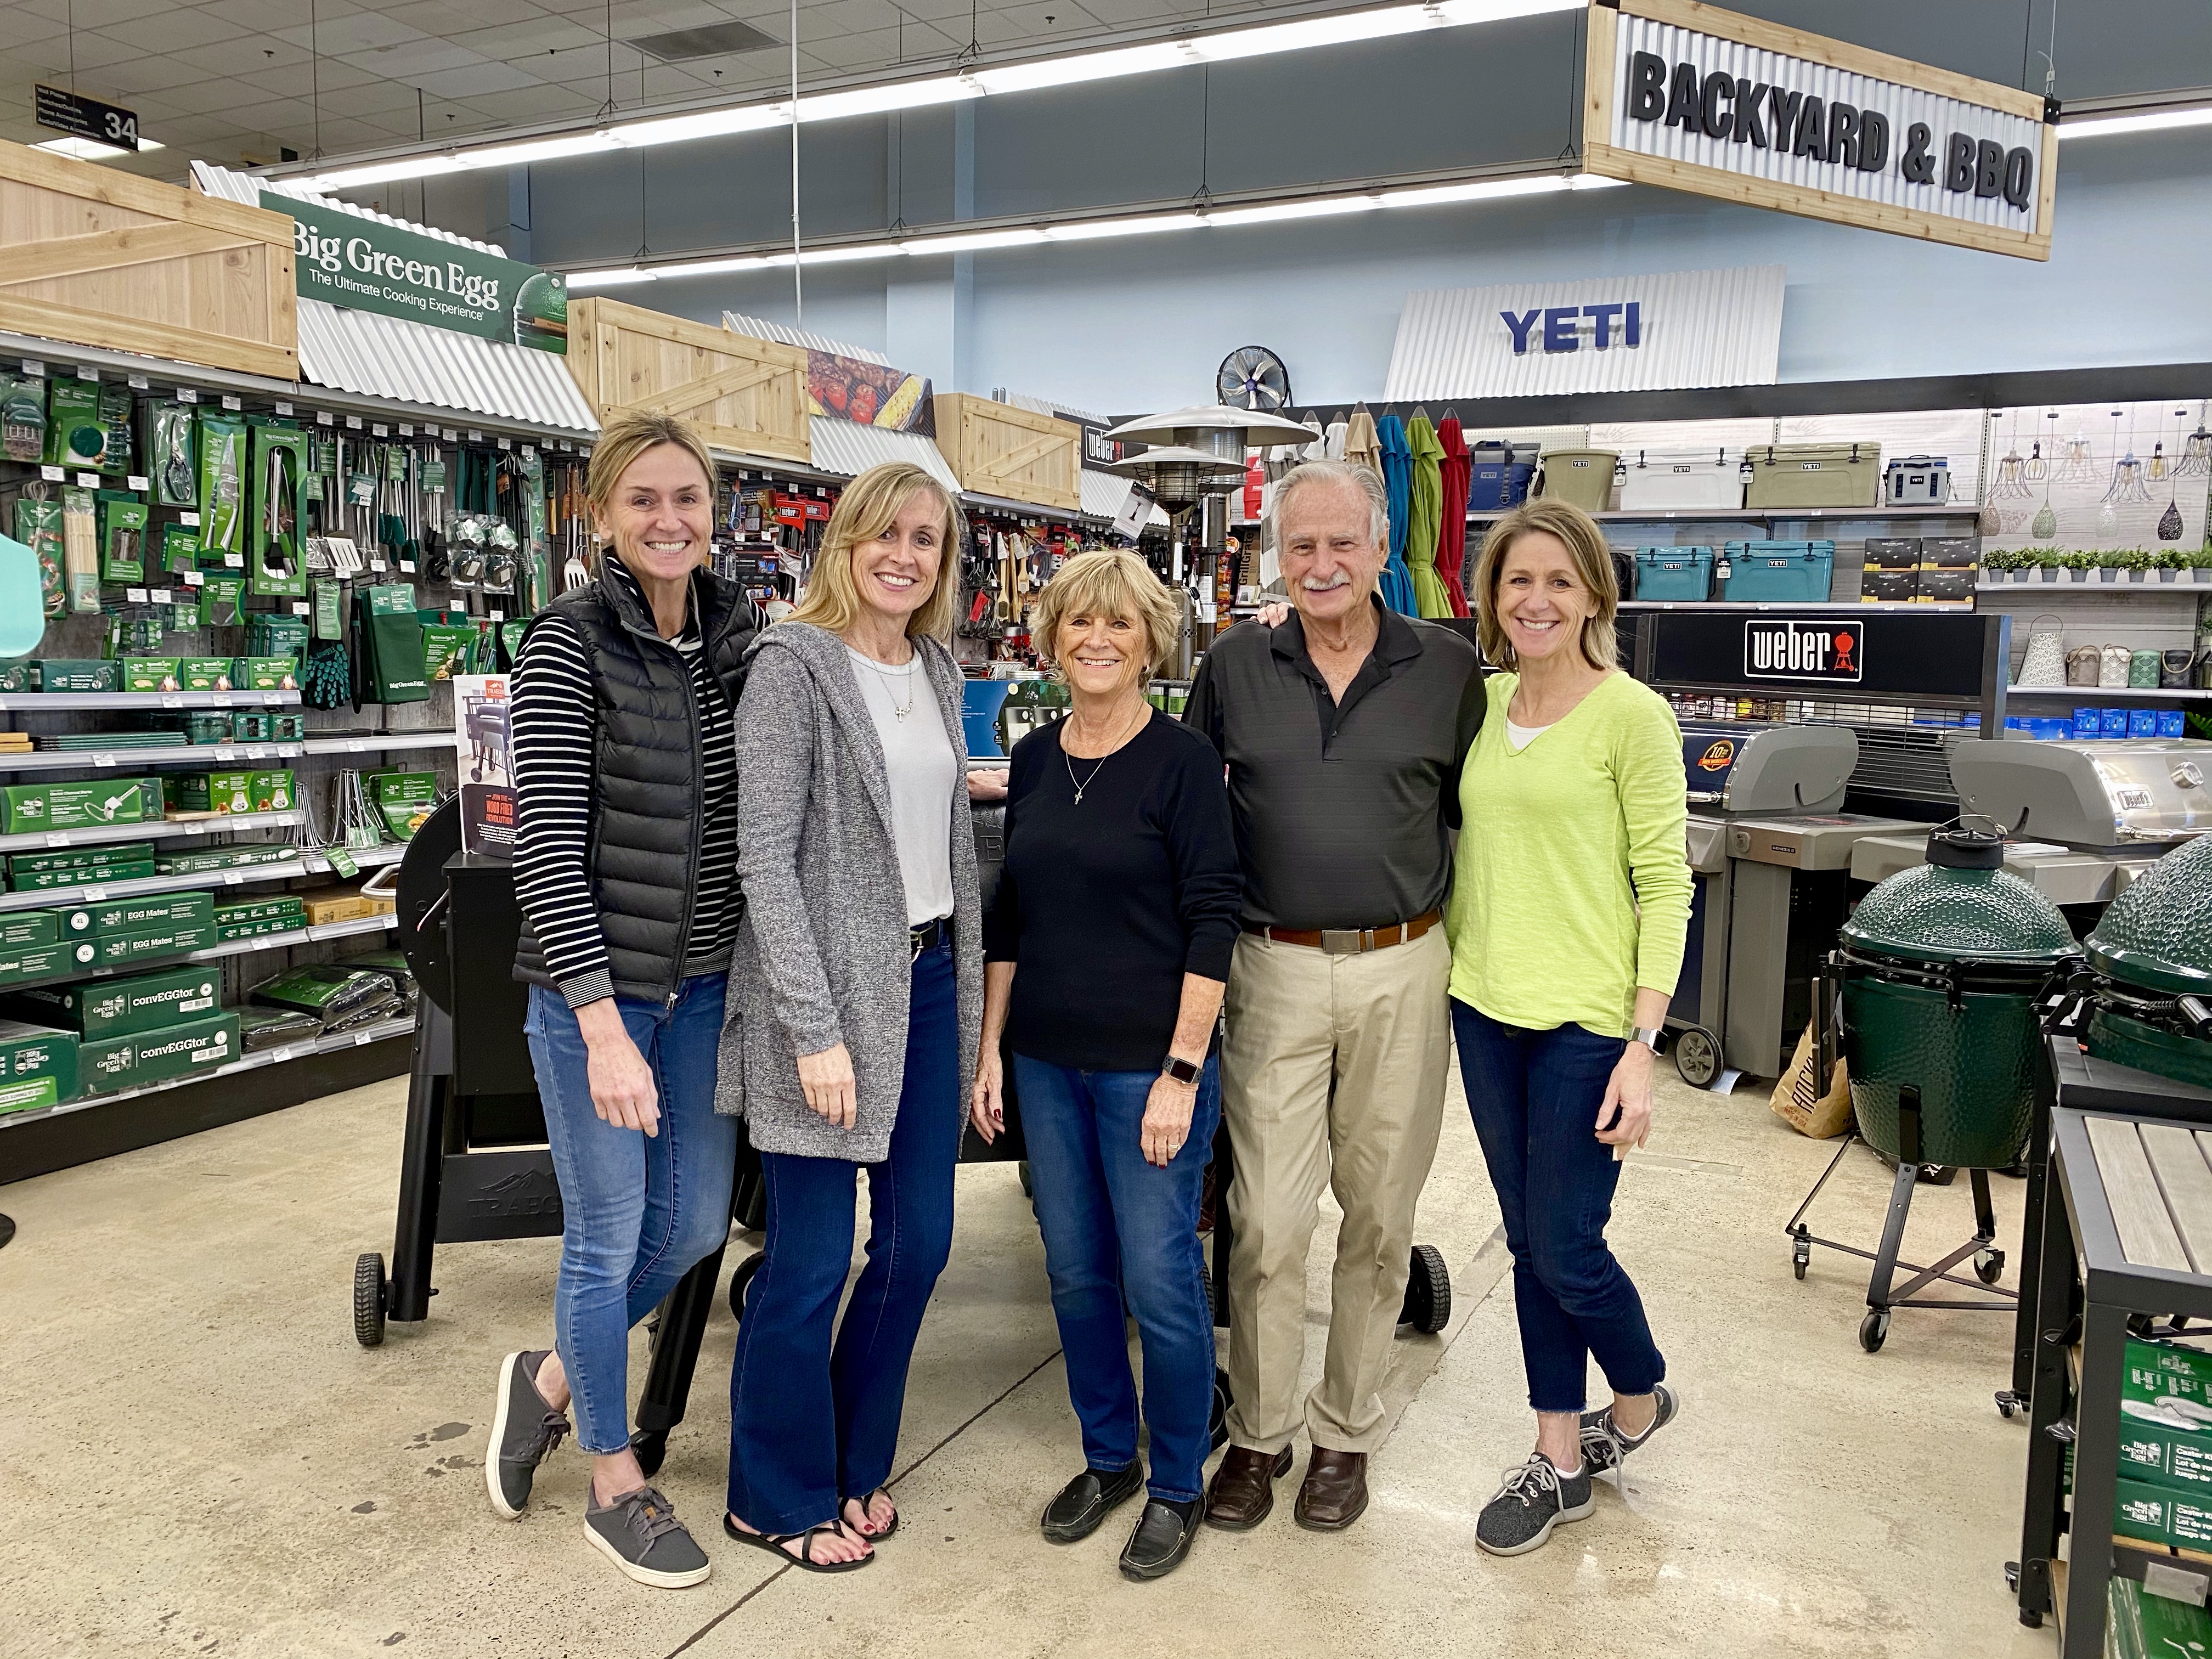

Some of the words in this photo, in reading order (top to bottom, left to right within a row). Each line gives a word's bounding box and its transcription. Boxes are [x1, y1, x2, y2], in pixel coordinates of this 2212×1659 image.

[105, 112, 138, 143] 34
[1631, 50, 1889, 172] BACKYARD
[1903, 122, 1936, 184] &
[1948, 132, 2034, 213] BBQ
[294, 221, 342, 272] Big
[346, 238, 443, 291] Green
[447, 262, 500, 312] Egg
[308, 268, 331, 285] The
[334, 274, 380, 297] Ultimate
[382, 287, 426, 310] Cooking
[429, 298, 483, 321] Experience
[1499, 302, 1640, 353] YETI
[1088, 431, 1115, 461] weber
[1239, 532, 1254, 585] GrillGrate
[1754, 624, 1830, 671] weber
[1709, 746, 1724, 759] 10
[128, 911, 144, 920] EGG
[146, 909, 168, 917] Mates
[133, 940, 149, 949] EGG
[150, 938, 172, 946] Mates
[0, 962, 19, 971] ates
[133, 988, 194, 1007] convEGGtor
[93, 1005, 114, 1014] Green
[140, 1037, 207, 1059] convEGGtor
[107, 1052, 119, 1060] Big
[97, 1059, 119, 1069] Green
[106, 1064, 120, 1073] Egg
[1792, 1056, 1818, 1114] ROCK
[468, 1195, 560, 1219] TRAEG
[2121, 1445, 2147, 1455] Green
[2134, 1441, 2147, 1450] Big
[2131, 1453, 2147, 1462] Egg
[2176, 1448, 2203, 1458] Caster
[2176, 1458, 2188, 1467] Lot
[2175, 1470, 2198, 1480] Juego
[2122, 1504, 2148, 1515] Green
[2135, 1501, 2148, 1509] Big
[2132, 1513, 2147, 1521] Egg
[2177, 1508, 2203, 1517] Caster
[2176, 1517, 2189, 1526] Lot
[2176, 1528, 2199, 1538] Juego
